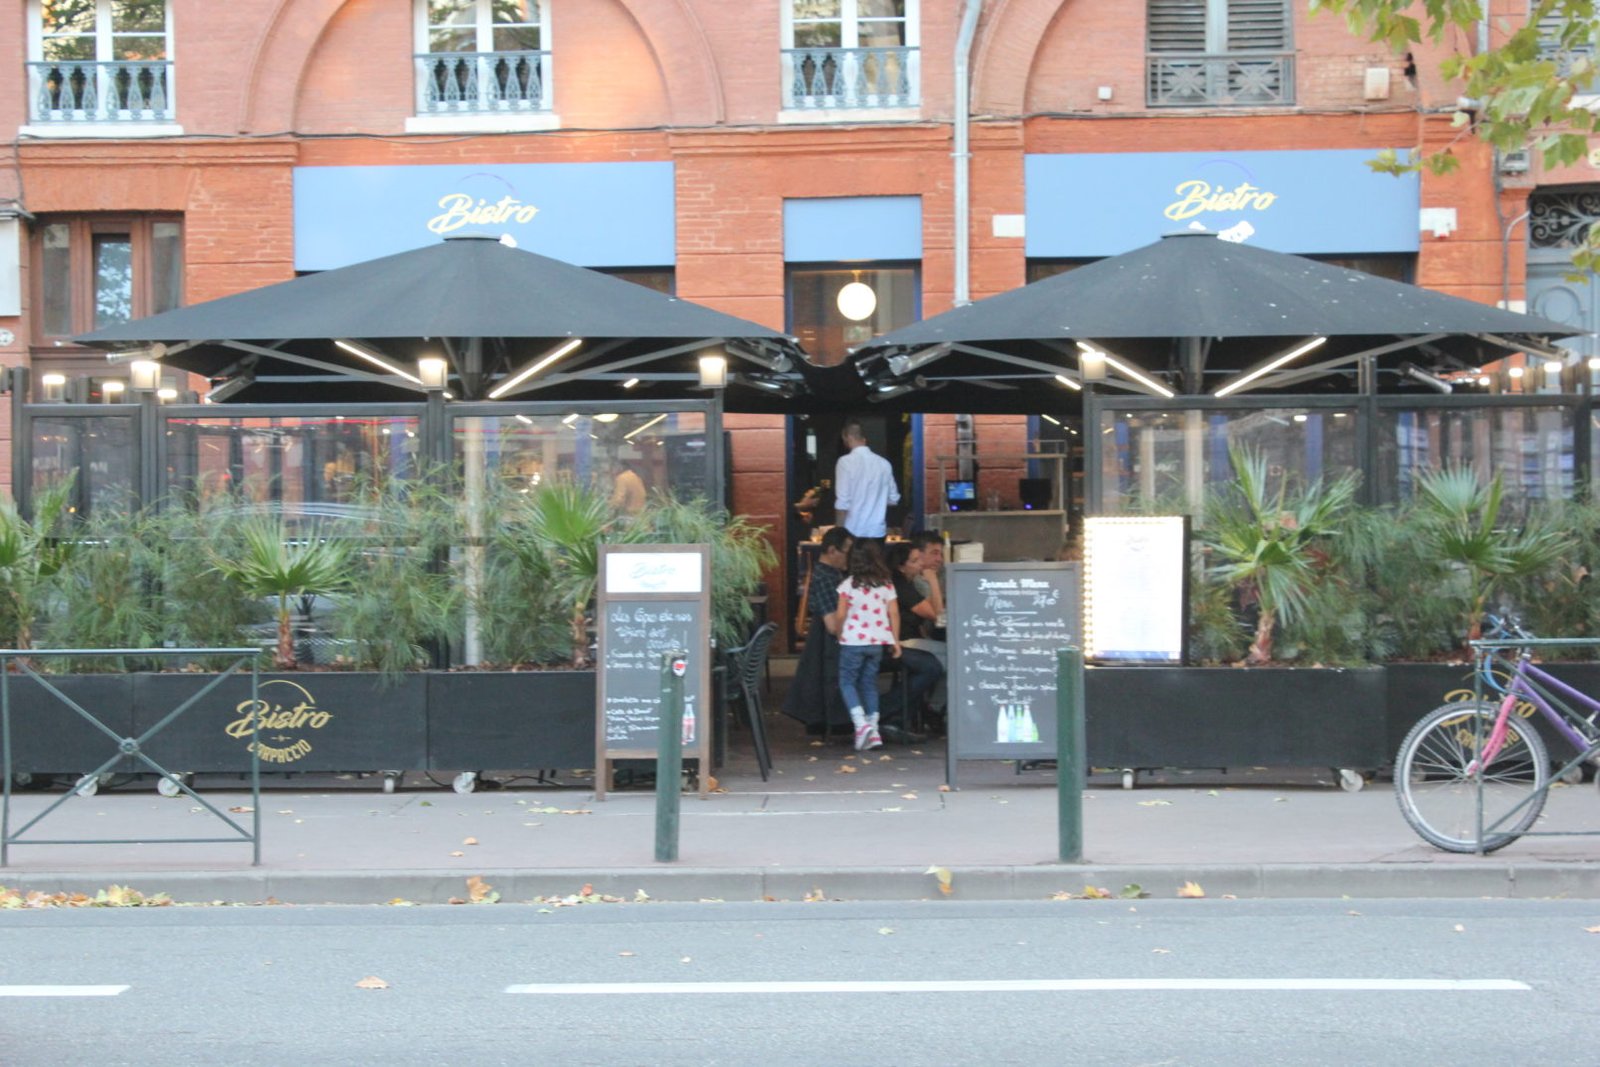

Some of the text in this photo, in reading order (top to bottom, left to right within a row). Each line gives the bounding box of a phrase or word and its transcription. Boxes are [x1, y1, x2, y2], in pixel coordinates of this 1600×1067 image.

[427, 193, 540, 234] Bistro
[1163, 180, 1279, 221] Bistro
[225, 699, 334, 739] Bistro
